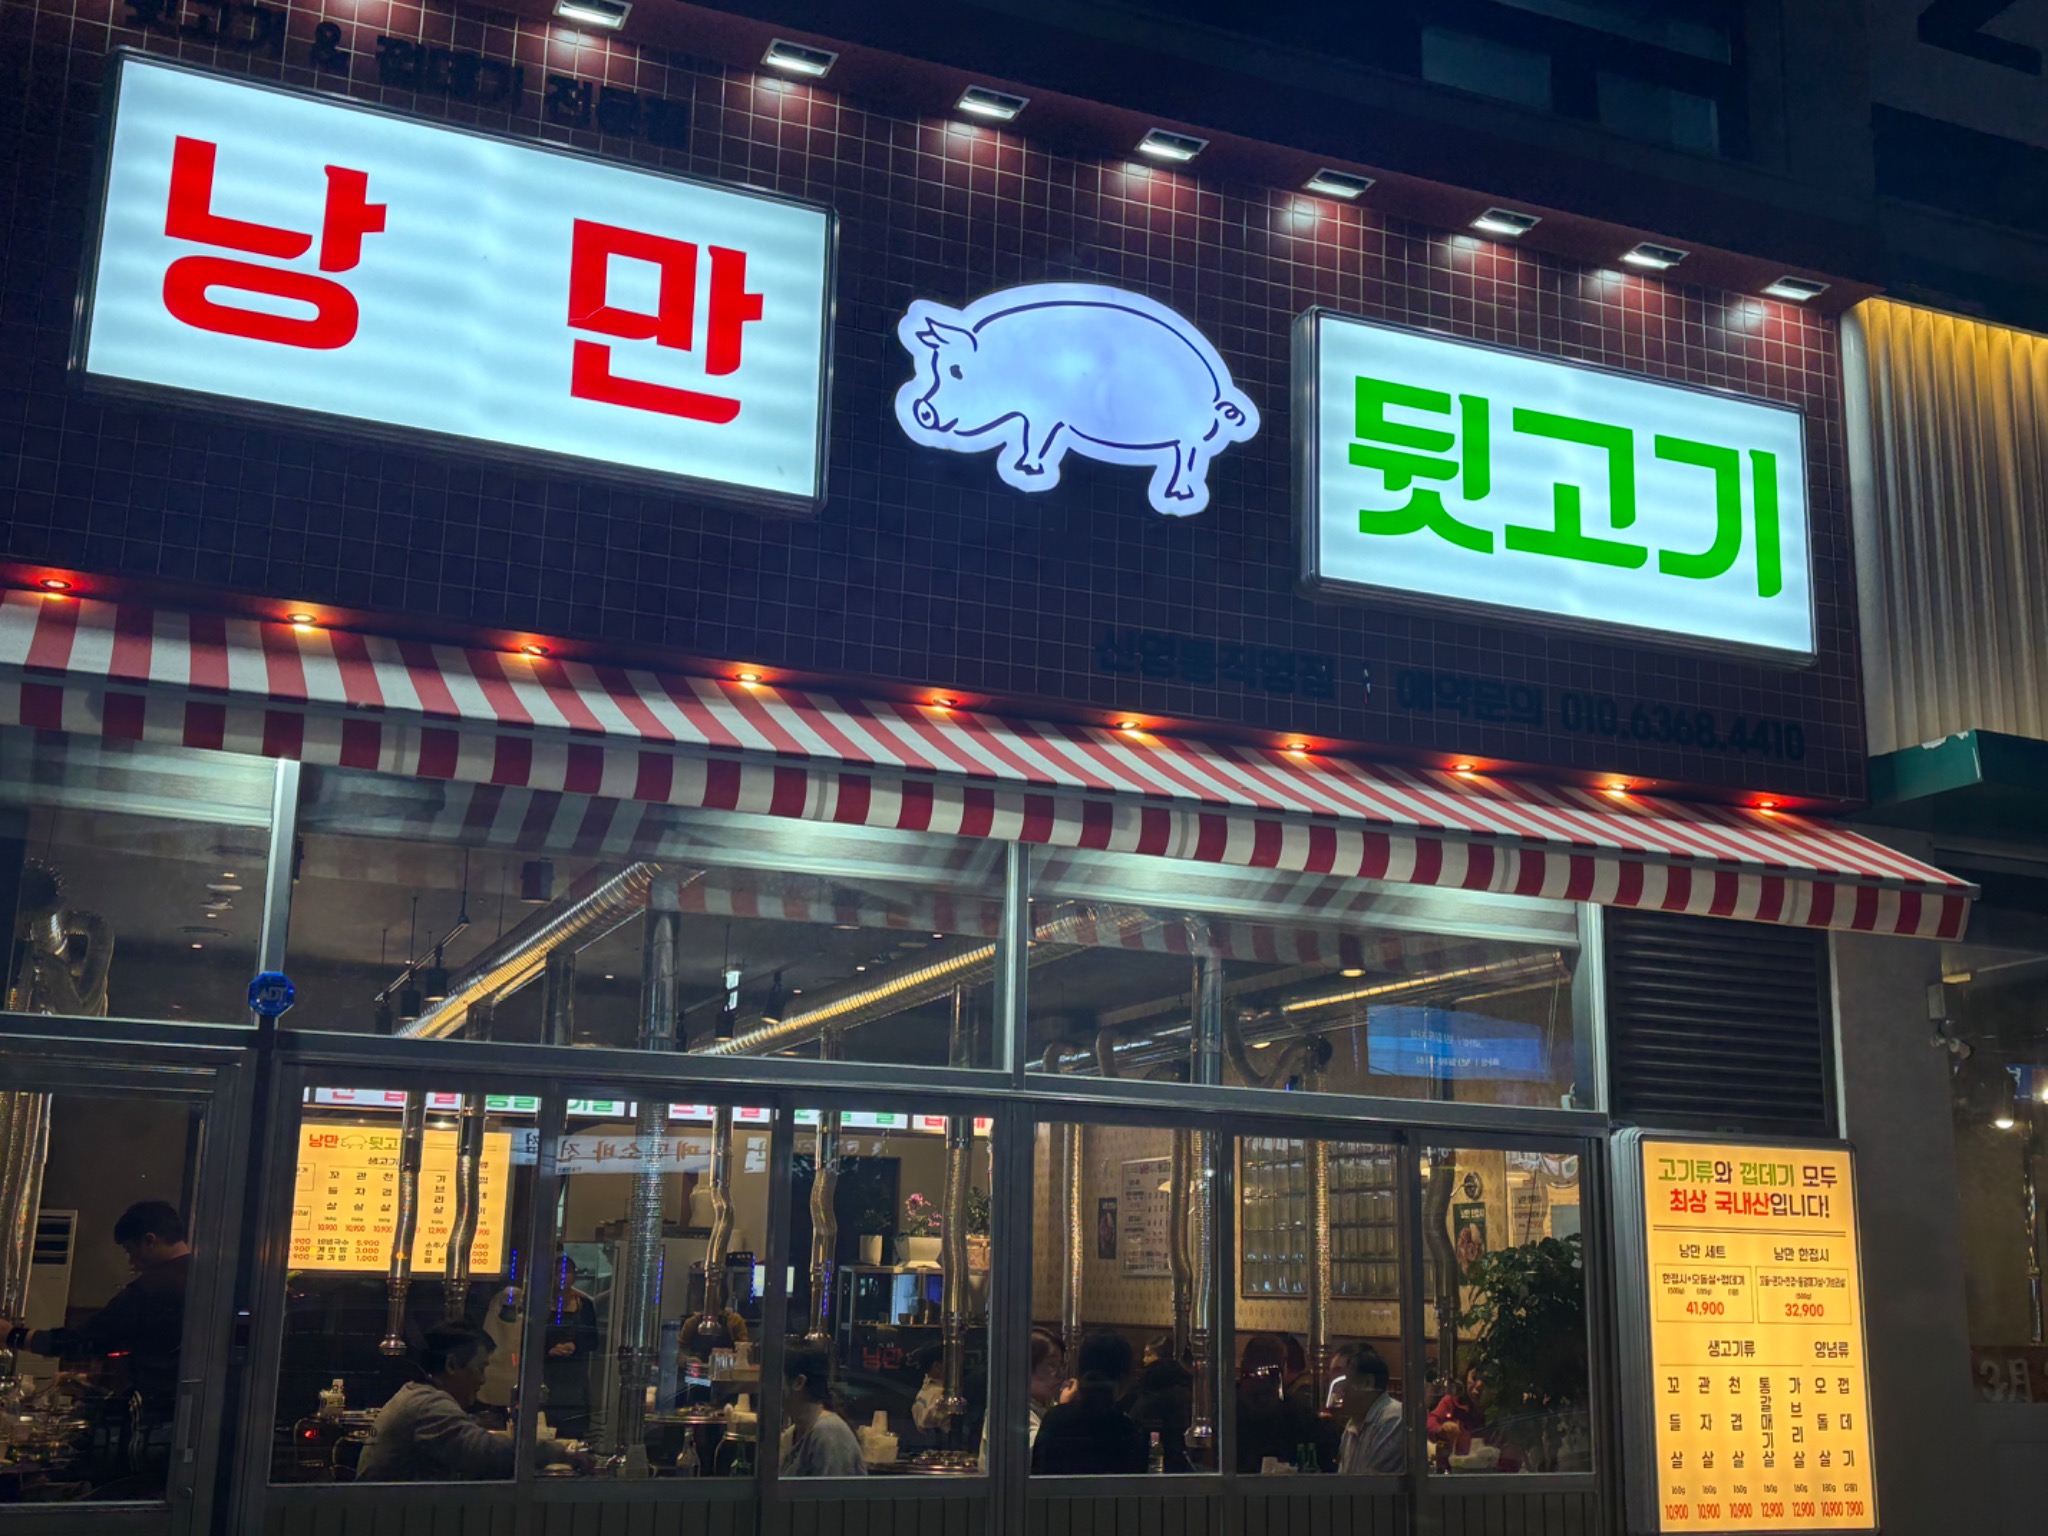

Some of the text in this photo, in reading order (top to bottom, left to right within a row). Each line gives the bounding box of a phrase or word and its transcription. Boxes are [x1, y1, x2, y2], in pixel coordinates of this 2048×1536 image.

[312, 20, 348, 74] &
[1349, 376, 1782, 598] 뒷고기
[1396, 669, 1805, 760] 예약문의 010.6368.4410
[258, 986, 288, 1001] ADT
[309, 1134, 398, 1151] 낭만 뒷고
[1658, 1158, 1838, 1188] 고기류와 껍데기 모두
[1670, 1189, 1830, 1218] 최상 국내산입니다!
[1679, 1244, 1726, 1259] 낭만 세트
[1774, 1247, 1829, 1262] 낭만 한접시
[1686, 1301, 1724, 1316] 41,900
[1785, 1303, 1824, 1318] 32,900
[863, 1346, 903, 1371] 낭만
[1708, 1340, 1755, 1358] 생고기류
[1814, 1341, 1849, 1358] 양념류
[1667, 1376, 1683, 1469] 꼬들살
[1698, 1376, 1714, 1469] 관자살
[1729, 1376, 1744, 1469] 천겹살
[1759, 1376, 1775, 1468] 통갈매기살
[1789, 1377, 1805, 1469] 가브리살
[1815, 1377, 1831, 1468] 오돌살
[1837, 1377, 1855, 1467] 껍데기
[1665, 1501, 1863, 1520] 10,900 10,900 10,900 12,900 12,900 10,900 7,900
